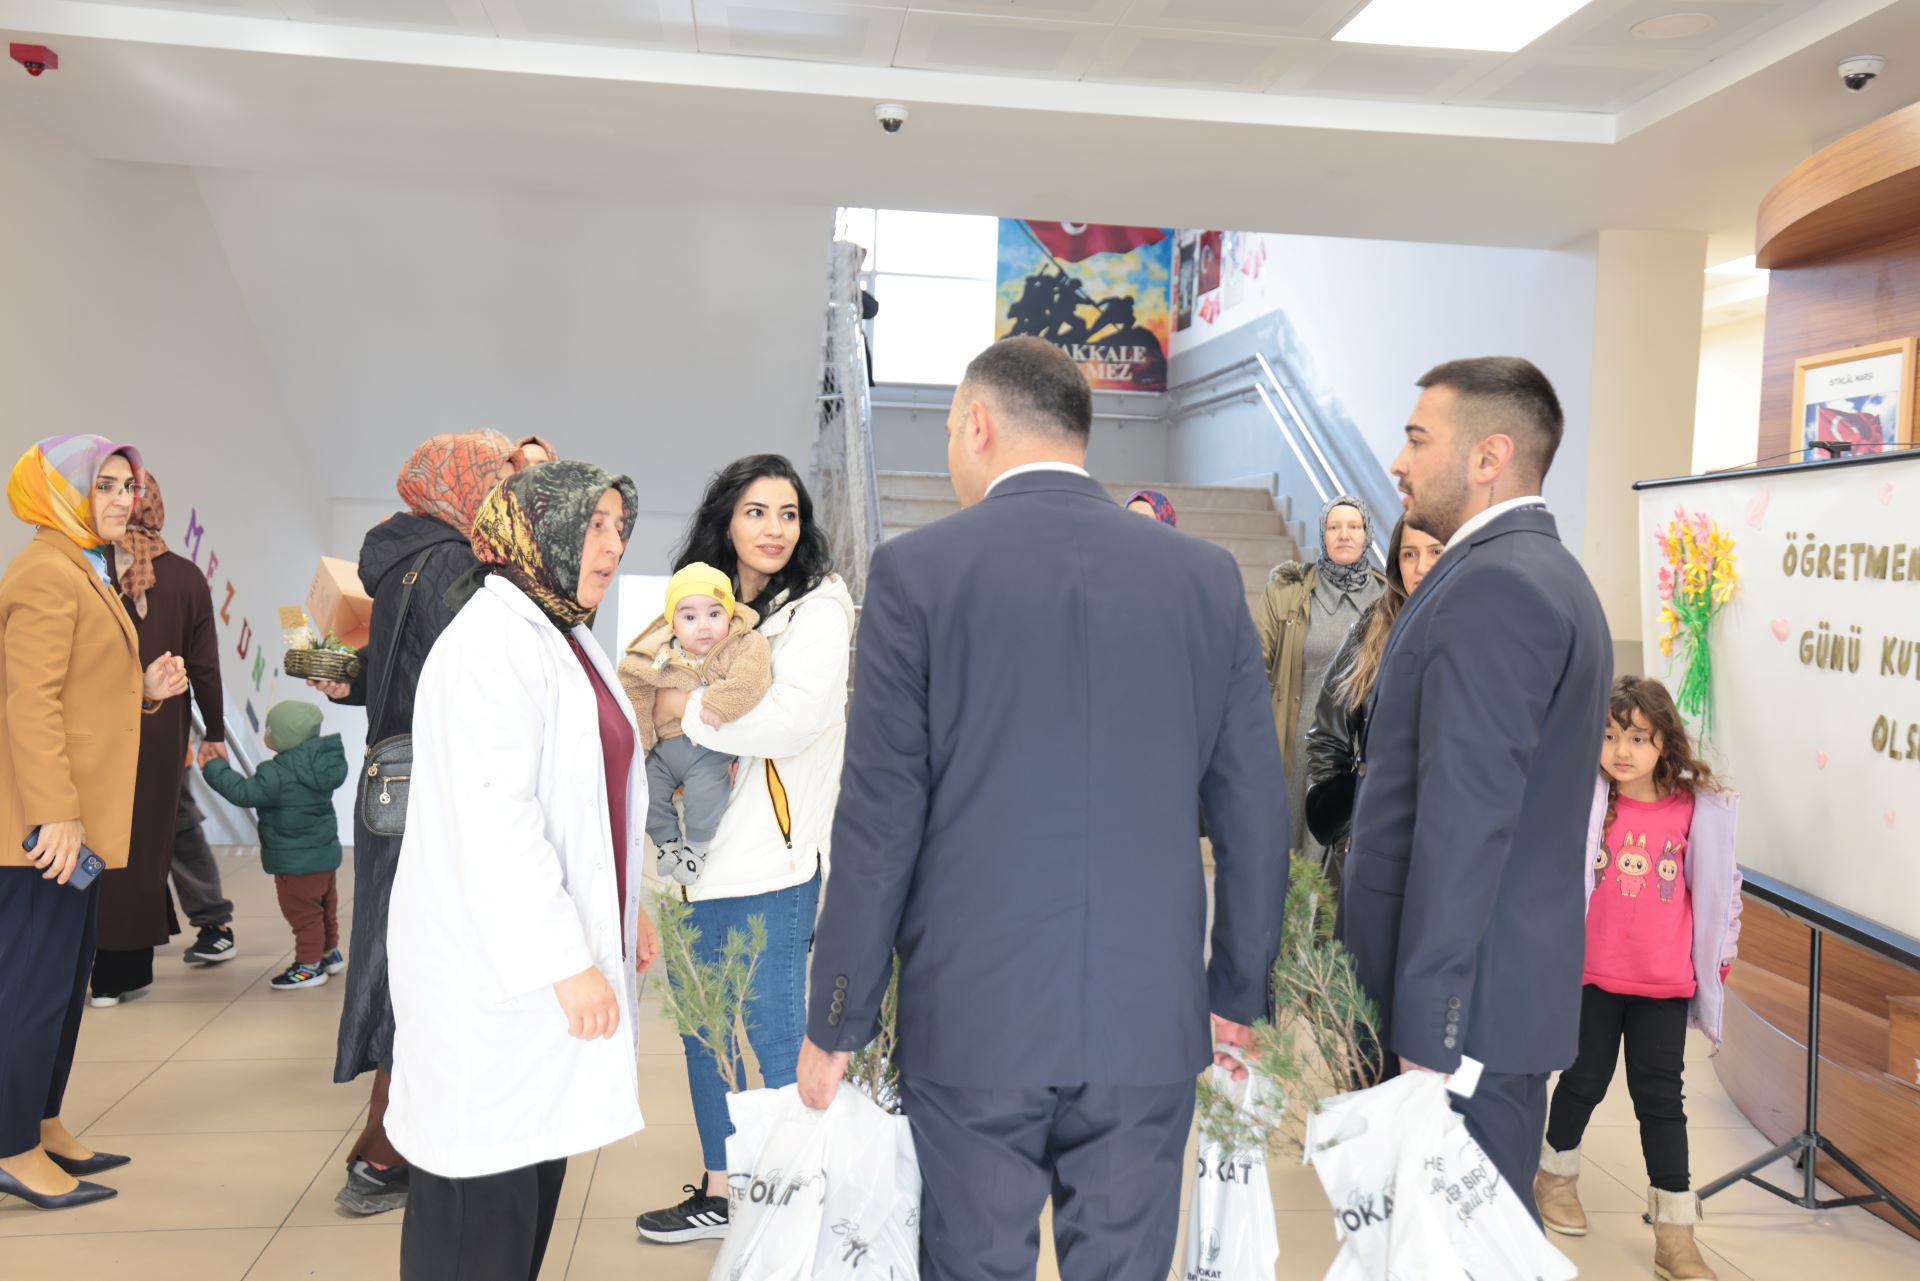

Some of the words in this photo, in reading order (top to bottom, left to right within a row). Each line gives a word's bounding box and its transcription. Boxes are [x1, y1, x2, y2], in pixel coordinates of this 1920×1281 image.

[1055, 343, 1147, 363] AKKALE
[1083, 362, 1133, 381] MEZ
[1799, 620, 1863, 674] GÜNÜ
[1871, 714, 1920, 762] OLS
